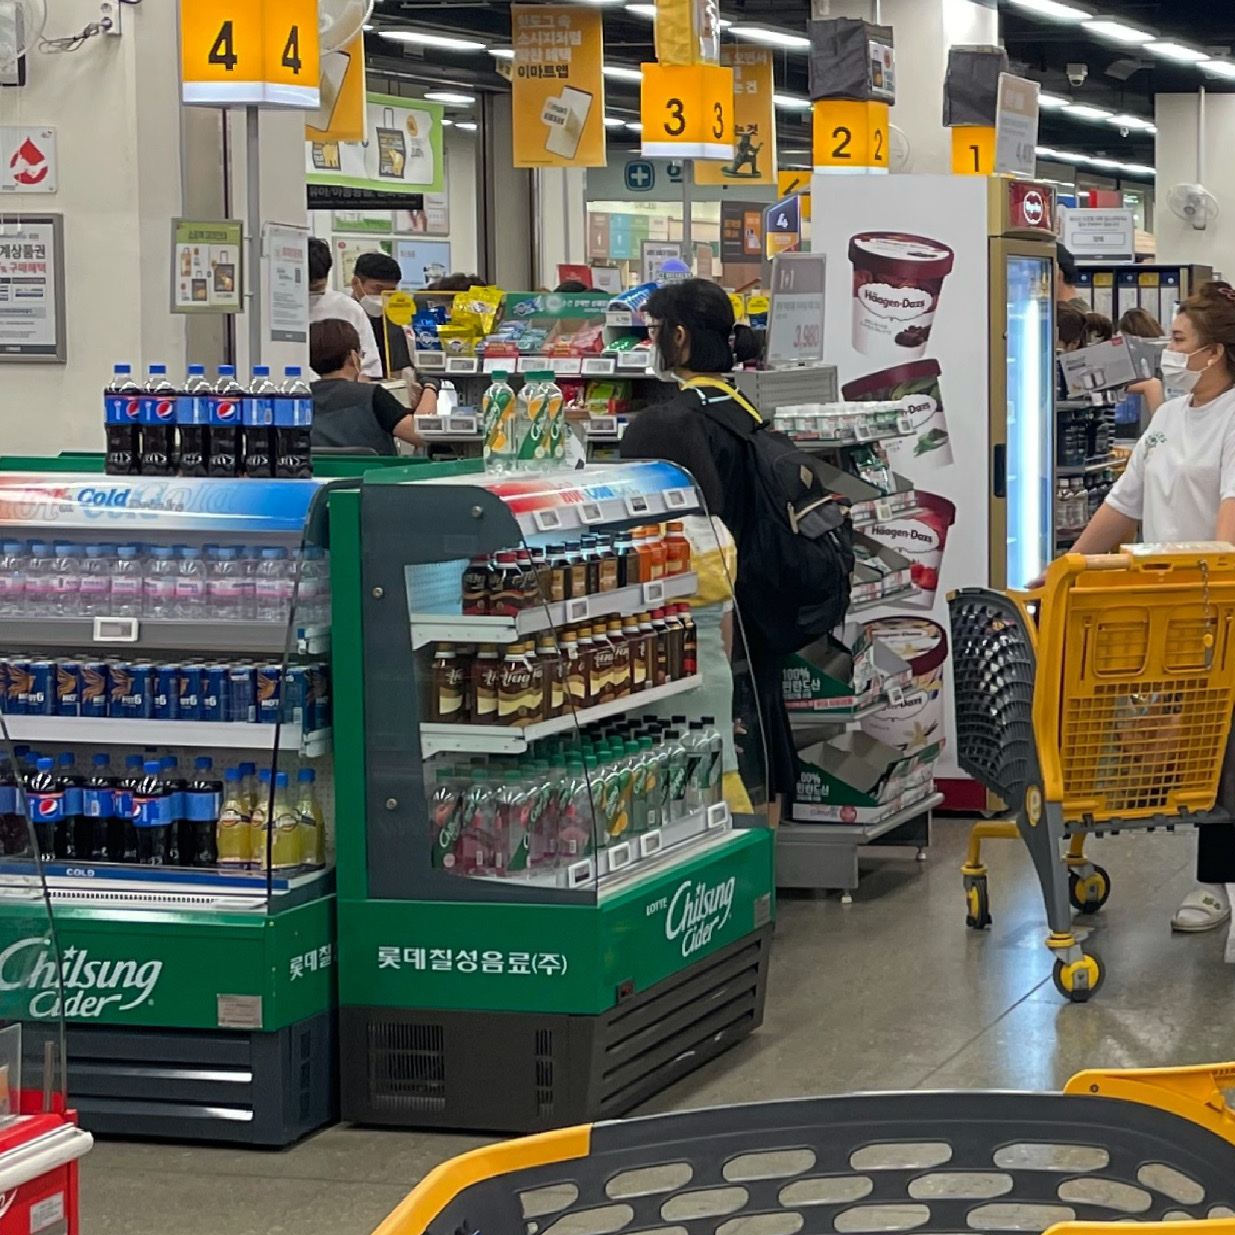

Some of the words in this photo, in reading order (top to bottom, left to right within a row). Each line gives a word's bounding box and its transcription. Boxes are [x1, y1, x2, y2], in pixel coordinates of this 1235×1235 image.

[208, 20, 238, 71] 4
[281, 25, 302, 75] 4
[517, 65, 569, 79] 이마트앱
[664, 98, 686, 137] 3
[712, 102, 724, 139] 3
[831, 126, 852, 159] 2
[874, 129, 883, 161] 2
[969, 144, 981, 172] 1
[775, 212, 789, 229] 4
[864, 289, 926, 309] Häagen-Dazs
[77, 488, 132, 508] Cold
[646, 897, 668, 916] LOTTE
[665, 876, 736, 940] Chilsung
[682, 916, 720, 957] Cider
[0, 937, 164, 1011] Chilsung
[377, 945, 568, 977] 롯데칠성음료(주)
[29, 990, 122, 1018] Cider
